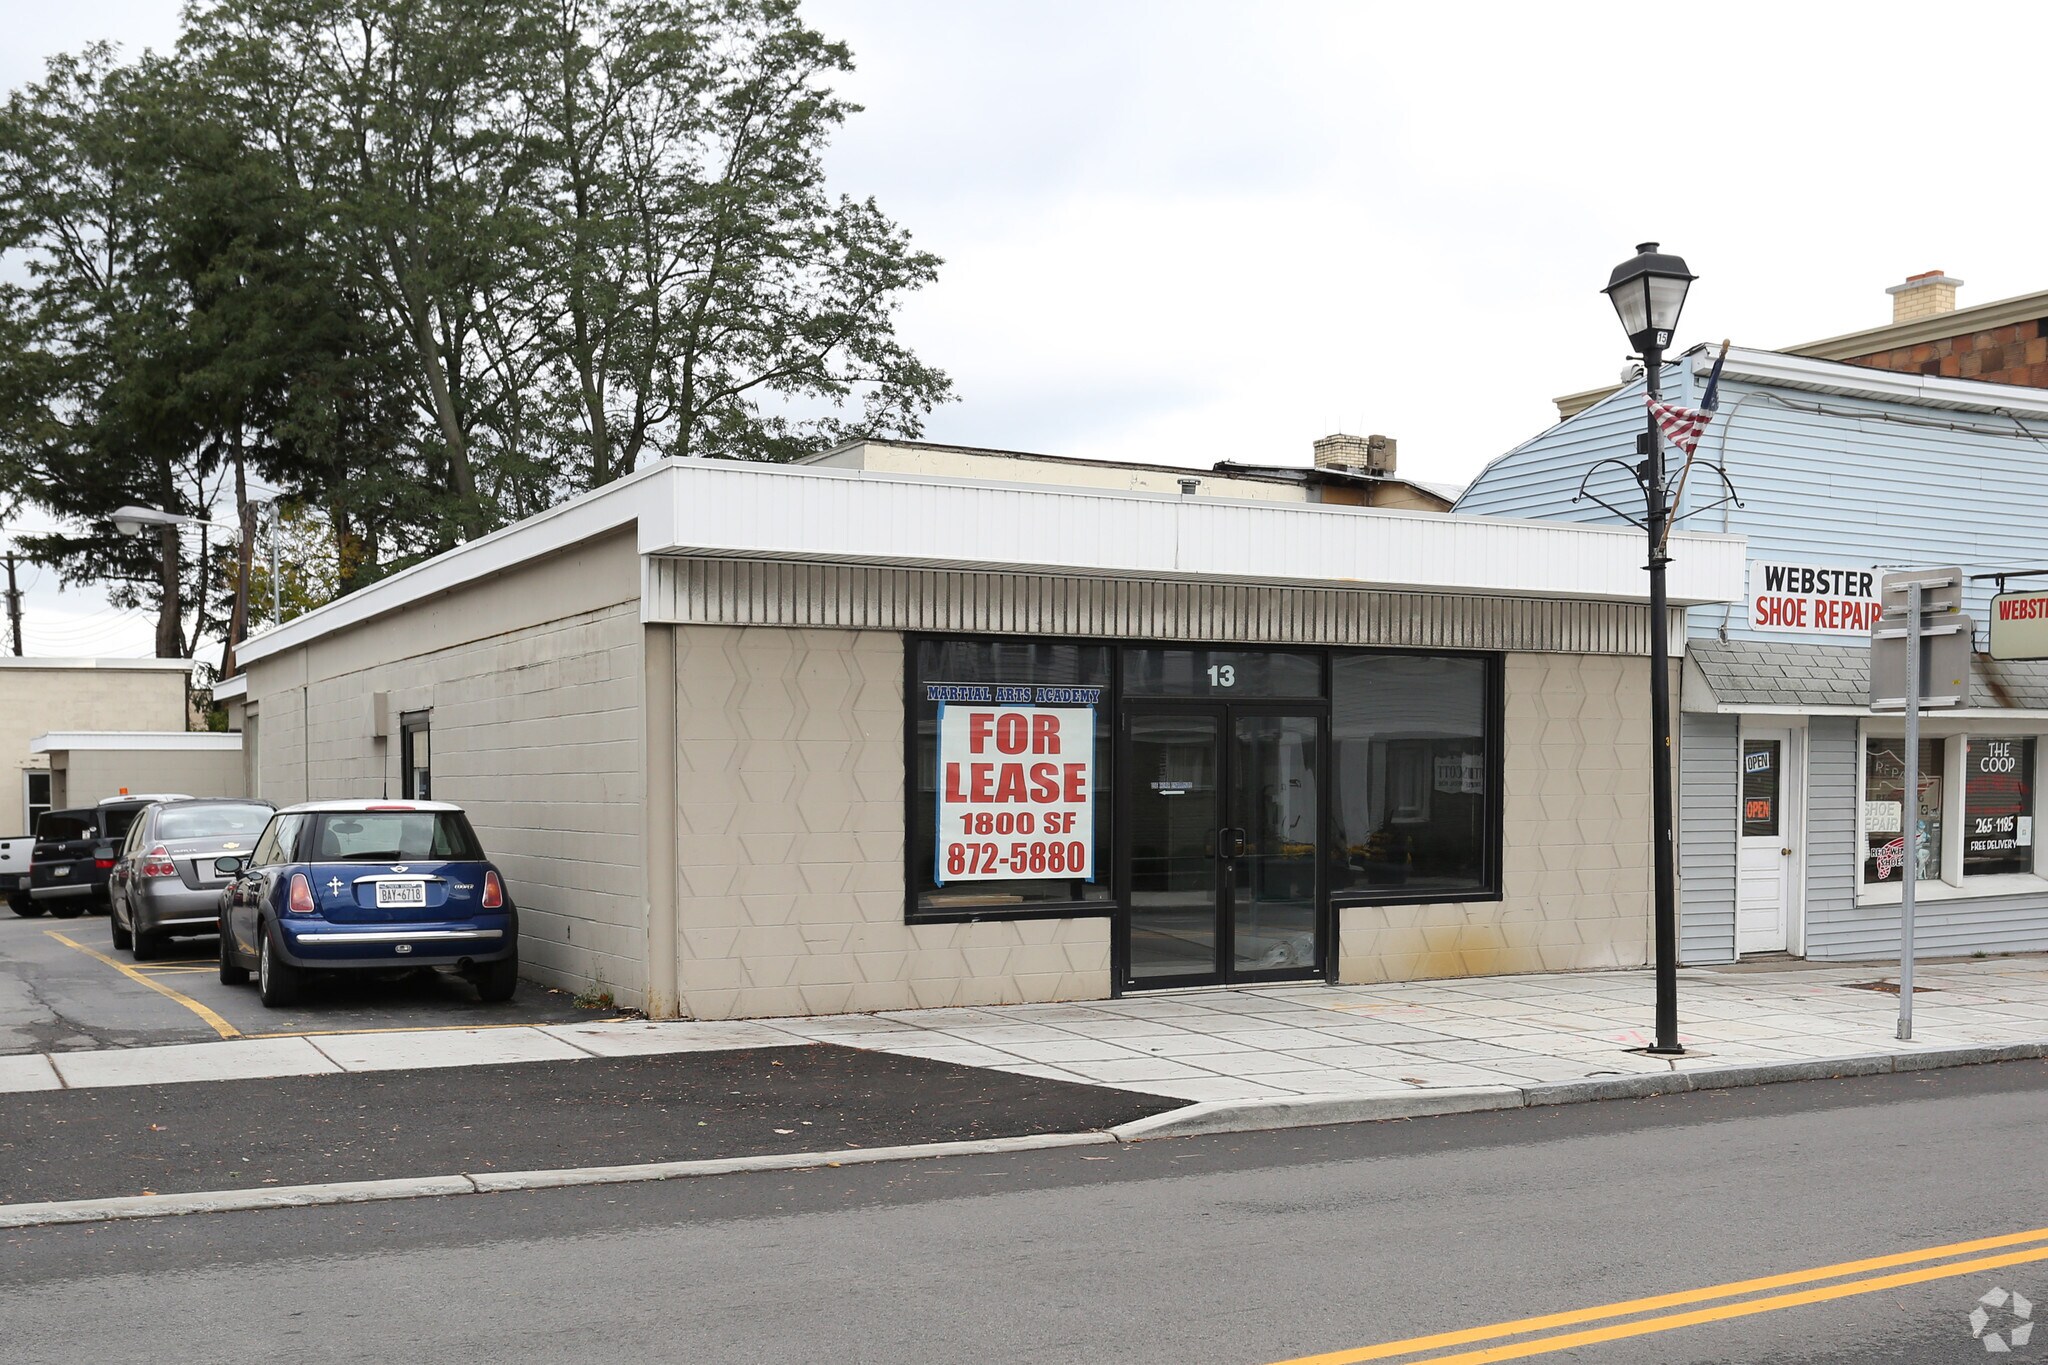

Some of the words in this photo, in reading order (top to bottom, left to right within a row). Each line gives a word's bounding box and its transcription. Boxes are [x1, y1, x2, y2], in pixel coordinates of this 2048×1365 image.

[1658, 333, 1667, 343] 15
[1765, 566, 1873, 597] WEBSTER
[1756, 596, 1807, 627] SHOE
[1814, 600, 1882, 630] REPAIR
[1207, 665, 1235, 687] 13
[927, 686, 991, 701] MARTIAL
[995, 687, 1032, 702] ARTS
[1035, 688, 1100, 703] ACADEMY
[969, 713, 1061, 755] FOR
[1988, 742, 2011, 757] THE
[1747, 754, 1767, 770] OPEN
[1980, 758, 2015, 772] COOP
[945, 762, 1086, 803] LEASE
[1747, 801, 1769, 818] OPEN
[1865, 802, 1895, 816] SHOE
[959, 812, 1035, 835] 1800
[1043, 812, 1077, 834] SF
[1865, 816, 1899, 831] EPAIR
[1975, 816, 2014, 833] 265-1185
[1871, 848, 1886, 857] RED
[1890, 847, 1904, 856] WI
[1970, 840, 1986, 851] FREE
[1987, 839, 2017, 850] DELIVERY
[947, 841, 1085, 875] 872-5880
